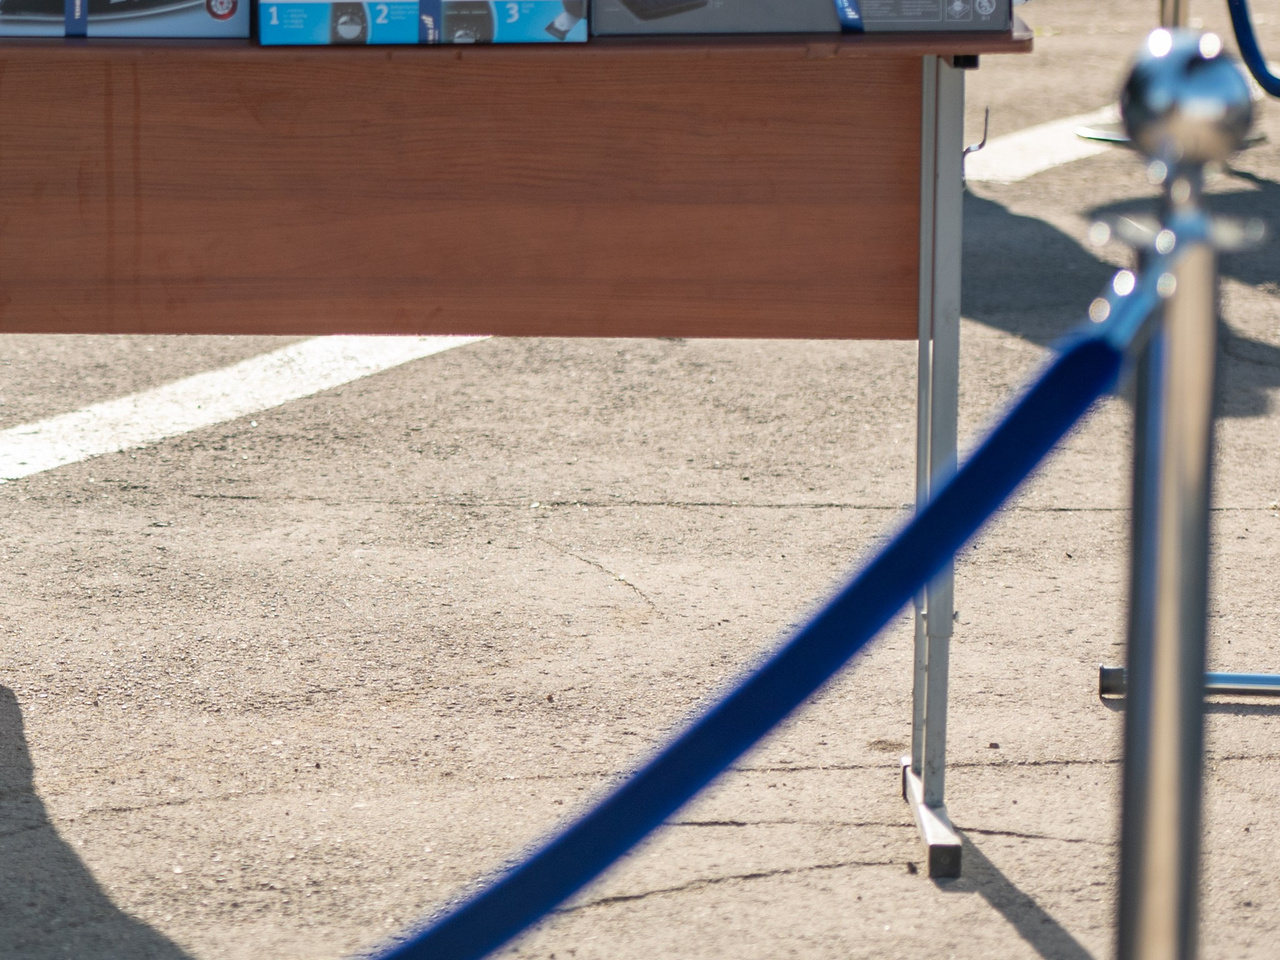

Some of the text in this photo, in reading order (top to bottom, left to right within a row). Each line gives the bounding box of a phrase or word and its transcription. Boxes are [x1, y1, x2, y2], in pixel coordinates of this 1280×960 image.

[268, 6, 279, 25] 1
[375, 4, 389, 24] 2
[505, 2, 520, 23] 3
